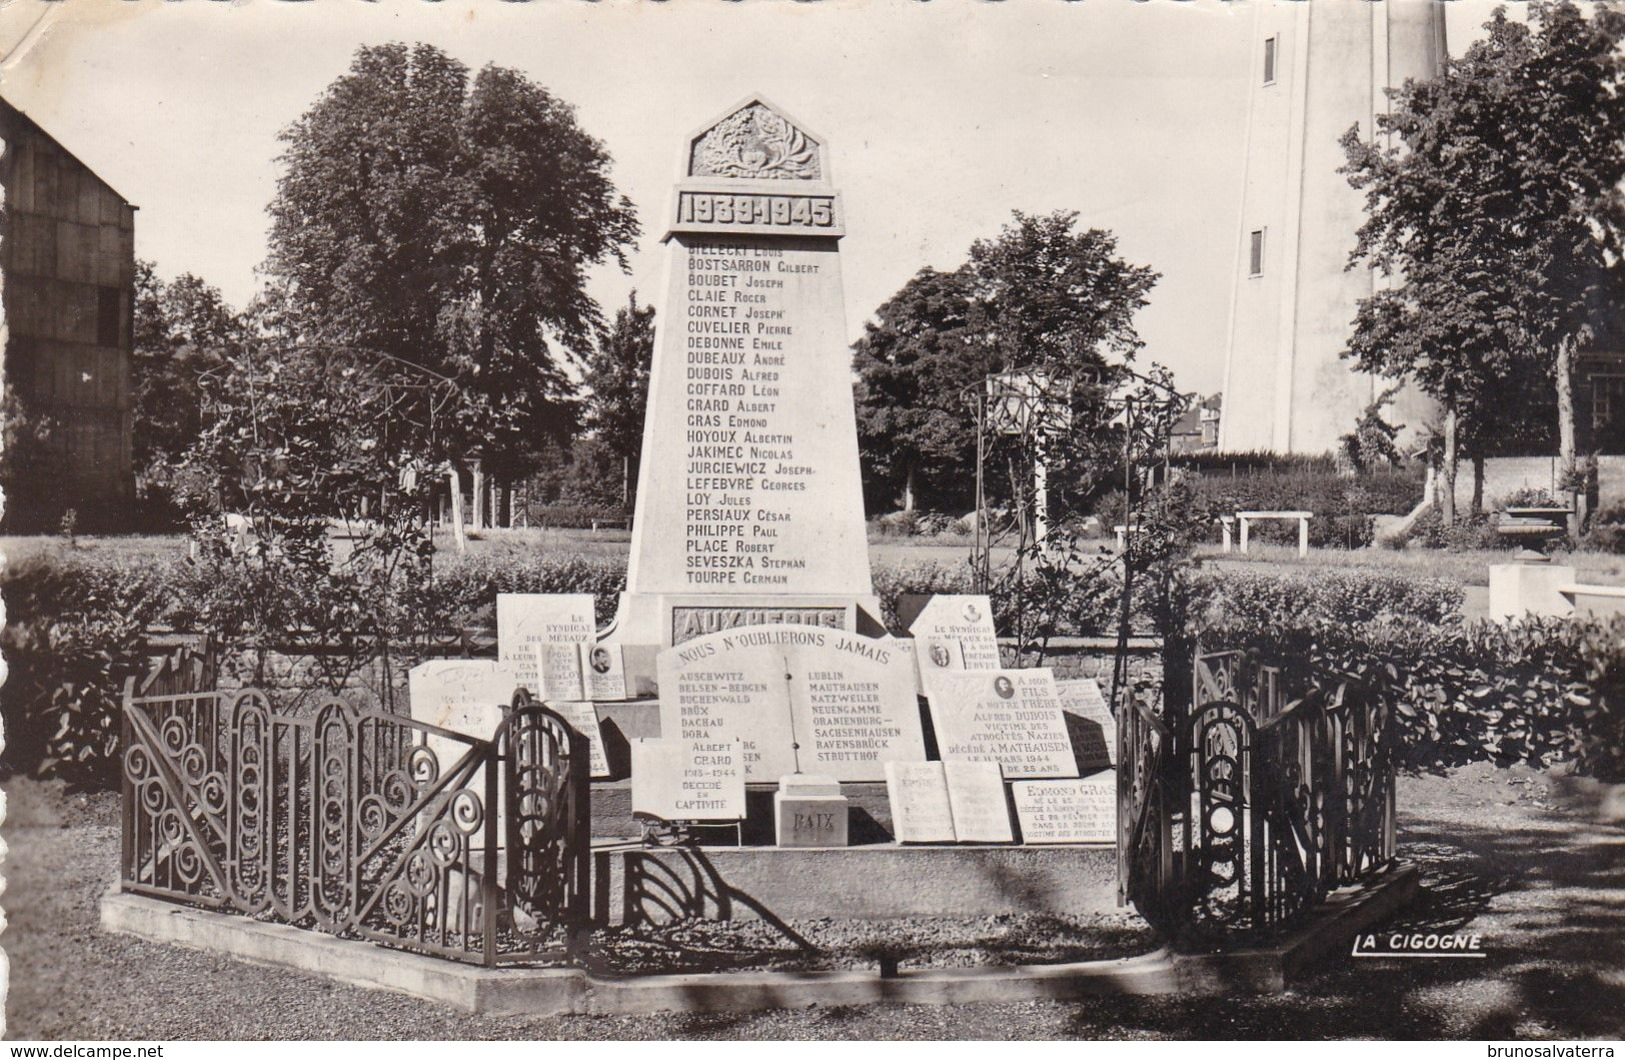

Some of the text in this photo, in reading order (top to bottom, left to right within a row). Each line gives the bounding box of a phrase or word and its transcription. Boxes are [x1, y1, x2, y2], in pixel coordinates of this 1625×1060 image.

[685, 195, 835, 227] 1939-1945
[688, 242, 784, 258] BIELECKI LOUIS
[688, 258, 770, 272] BOSTSARRON
[688, 275, 737, 287] BOUBET
[688, 290, 726, 302] CLAIE
[688, 305, 738, 318] CORNET
[687, 321, 750, 334] CUVELIER
[687, 337, 745, 349] DEBONNE
[687, 352, 745, 364] DUBEAUX
[687, 368, 733, 380] DUBOIS
[687, 399, 729, 412] GRARD
[687, 415, 721, 427] GRAS
[687, 430, 736, 443] HOYOUX
[687, 446, 743, 459] JAKIMEC
[687, 493, 711, 505] LOY
[687, 509, 750, 521] PERSIAUX
[687, 525, 744, 537] PHILIPPE
[687, 540, 728, 552] PLACE
[687, 555, 754, 568] SEVESZKA
[687, 571, 736, 584] TOURPE
[571, 614, 585, 623] LE
[684, 610, 741, 635] AUX
[545, 624, 592, 633] SYNDICAT
[934, 624, 946, 633] LE
[678, 642, 715, 666] NOUS
[723, 632, 826, 651] N'OUBLIERONS
[835, 637, 891, 665] JAMAIS
[679, 672, 744, 681] AUSCHWITZ
[808, 672, 844, 681] LUBLIN
[809, 682, 879, 692] MAUTHAUSEN
[1022, 687, 1049, 697] FILS
[679, 694, 750, 704] BUCHENWALD
[810, 694, 880, 703] NATZWEILER
[986, 700, 1020, 709] NOTRE
[680, 705, 709, 716] BRÜX
[811, 705, 882, 715] NEUENGAMME
[973, 710, 1057, 722] ALFRED DUBOIS
[681, 717, 724, 727] DACHAU
[984, 723, 1049, 731] VICTIME DES
[682, 730, 710, 740] DORA
[814, 728, 901, 737] SACHSENHAUSEN
[1028, 730, 1065, 740] NAZIES
[693, 742, 732, 752] ALBERT
[816, 738, 889, 749] RAVENSBRÜCK
[998, 742, 1069, 753] MATHAUSEN
[817, 752, 879, 761] STRUTTHOF
[994, 755, 1023, 763] MARS
[1026, 754, 1051, 763] 1944
[1007, 764, 1060, 773] DE 25 ANS
[794, 812, 835, 829] PAIX
